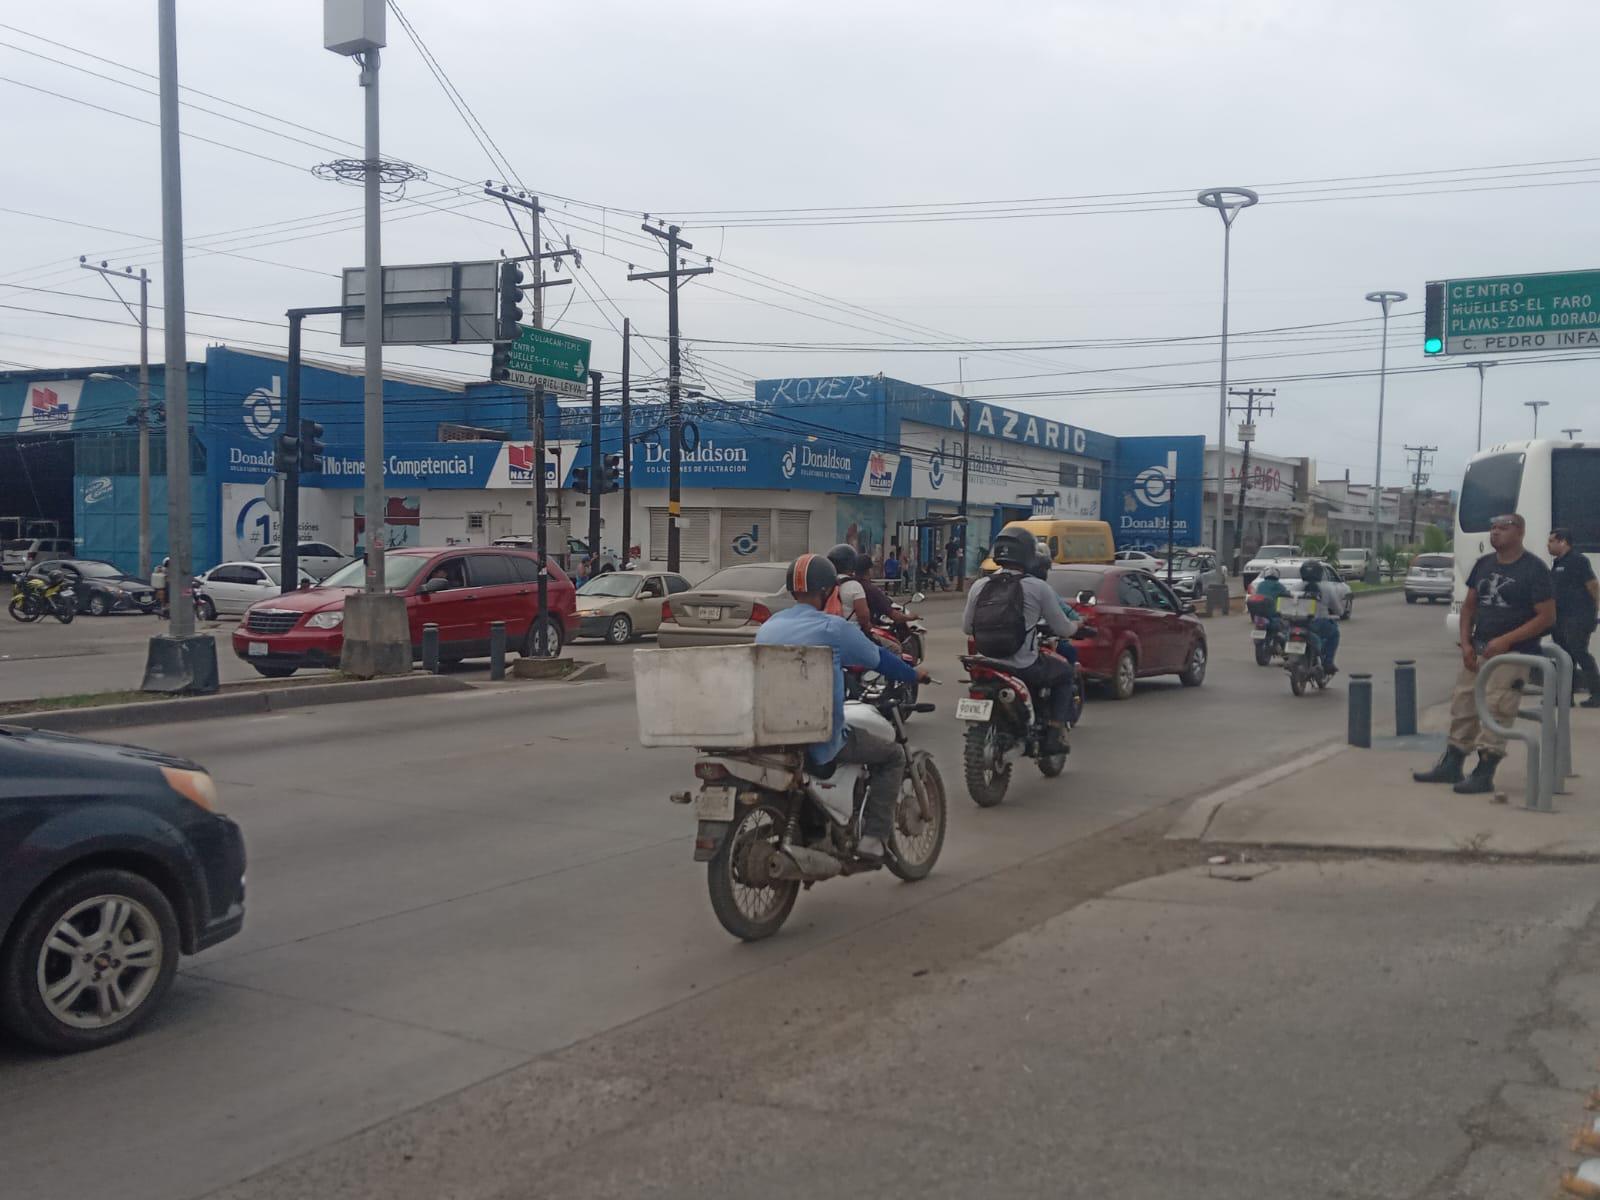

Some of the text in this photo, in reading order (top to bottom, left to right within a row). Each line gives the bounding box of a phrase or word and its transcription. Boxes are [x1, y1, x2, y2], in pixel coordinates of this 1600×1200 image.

[1452, 282, 1524, 299] CENTRO
[1452, 294, 1592, 315] MUELLES-EL FARO
[1452, 315, 1544, 331] PLAYAS-ZONA
[513, 342, 536, 353] ENTRO
[1463, 331, 1599, 350] C. PEDRO INFA
[951, 399, 1087, 453] NAZARIO
[229, 448, 275, 466] Donald
[801, 445, 851, 471] Donaldson
[952, 441, 1008, 474] Dnaldson
[343, 457, 388, 475] tenes
[389, 455, 474, 479] Competencia!
[510, 471, 556, 480] NAZO
[646, 465, 692, 473] SOLUCNES
